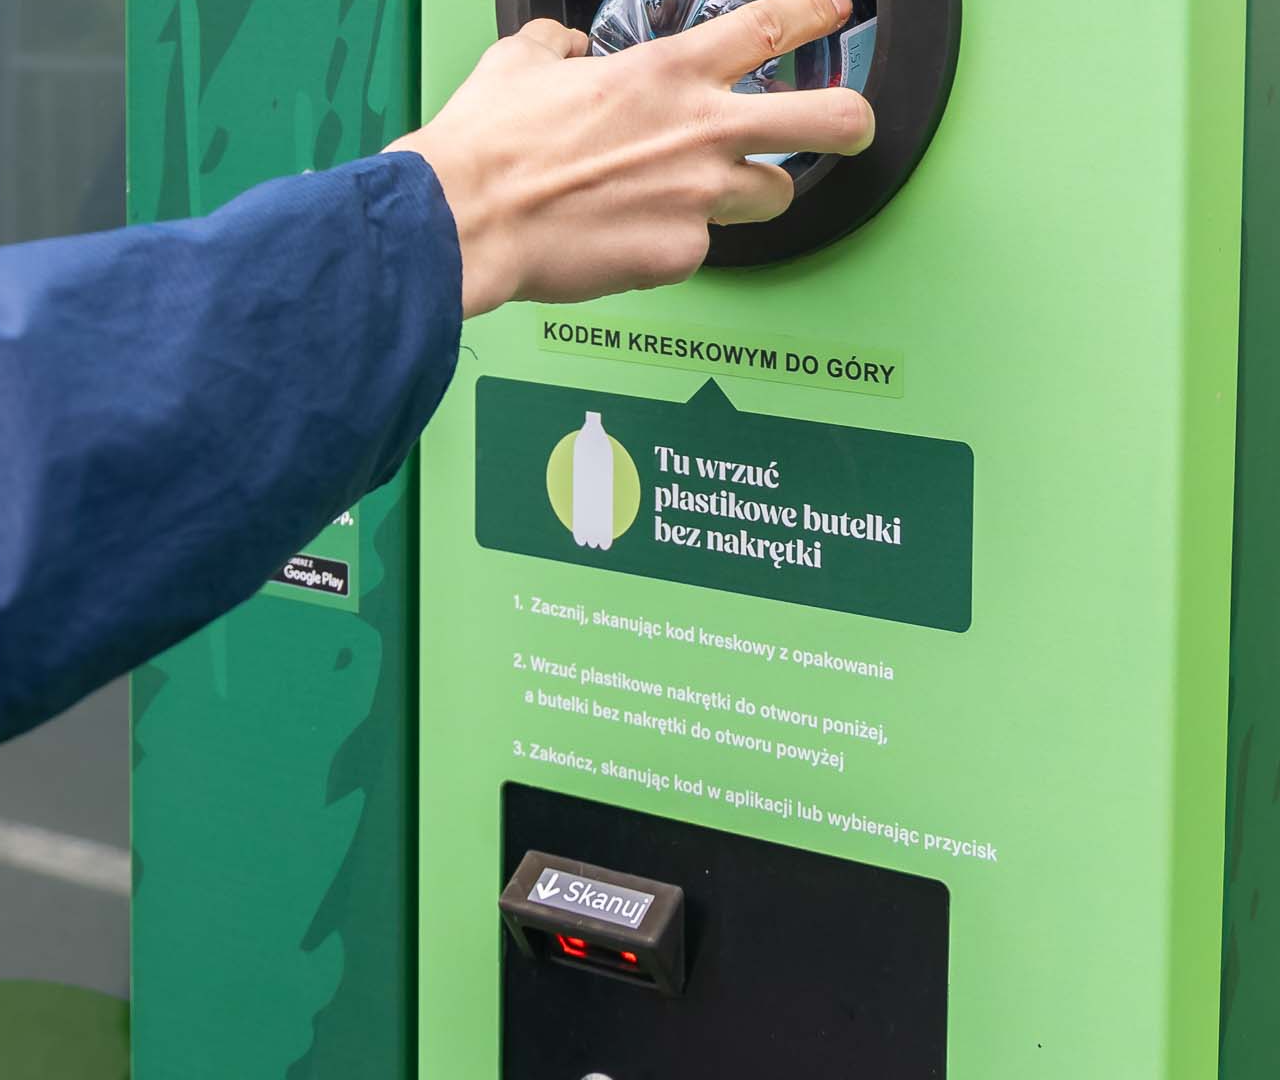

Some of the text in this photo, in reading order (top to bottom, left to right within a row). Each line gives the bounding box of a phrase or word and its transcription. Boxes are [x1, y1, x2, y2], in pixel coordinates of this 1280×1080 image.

[544, 321, 895, 385] KODEM KRESKOWYM DO GÓRY
[654, 445, 780, 489] Tu wrzuć
[655, 484, 902, 545] plastikowe butelki
[655, 516, 822, 569] bez nakrętki
[284, 564, 344, 591] Google Play
[513, 595, 894, 681] 1. Zacznij, skanując kod kreskowy z opakowania
[513, 653, 889, 746] 2. Wrzuć plastikowe nakrętki do otworu poniżej,
[524, 689, 844, 772] a butelki bez nakrętki do otworu powyżej
[512, 741, 998, 862] 3. Zakończ, skanując kod w aplikacji lub wybierając przycisk
[563, 880, 649, 925] Skanuj
